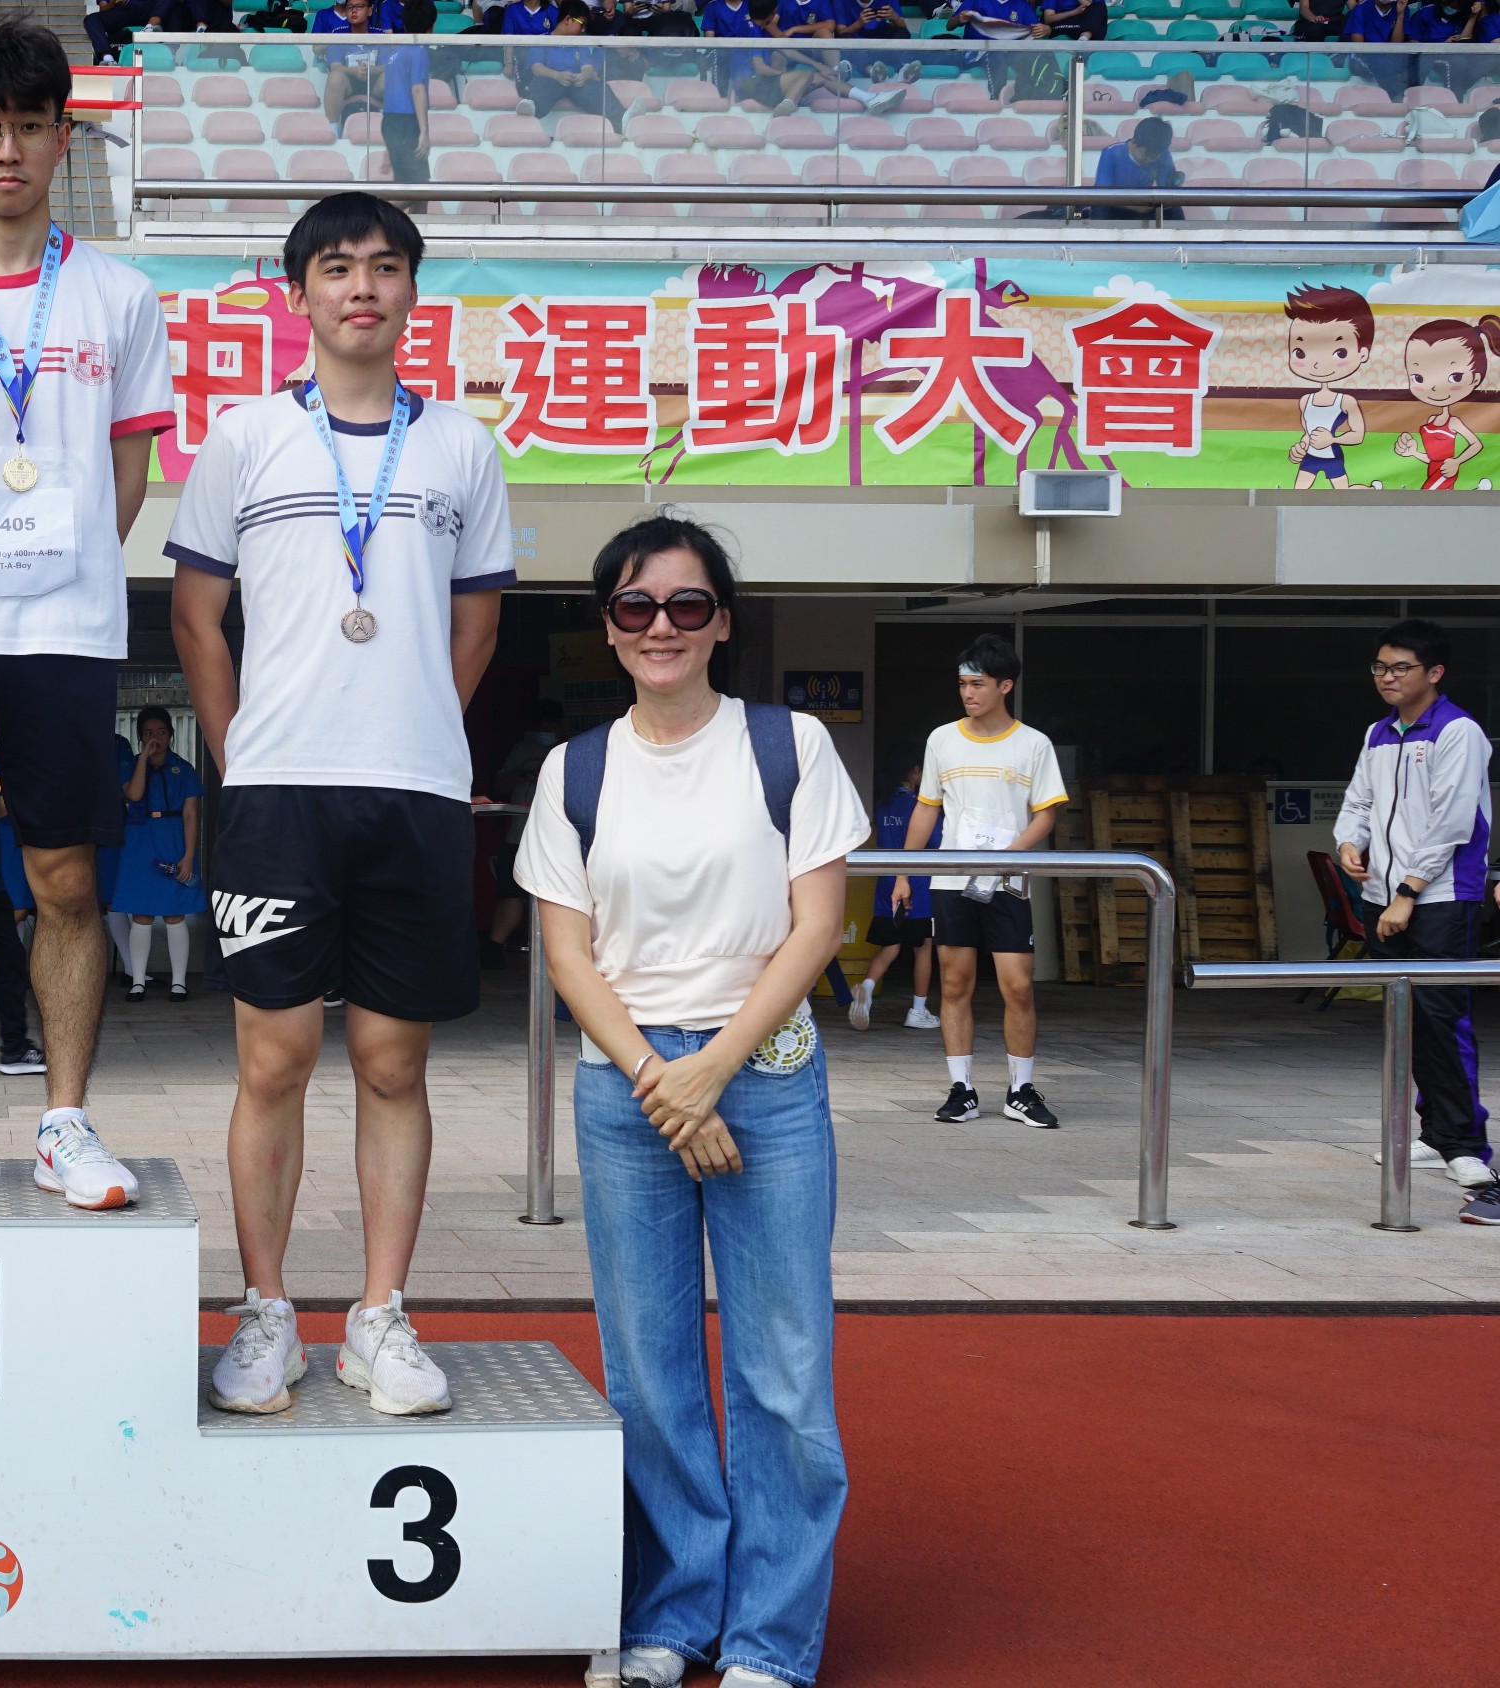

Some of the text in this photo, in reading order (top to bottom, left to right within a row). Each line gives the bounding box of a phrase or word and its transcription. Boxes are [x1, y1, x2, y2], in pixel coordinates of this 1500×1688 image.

[14, 549, 63, 557] 400m-A-Boy
[883, 815, 904, 827] LCW
[366, 1465, 462, 1604] 3
